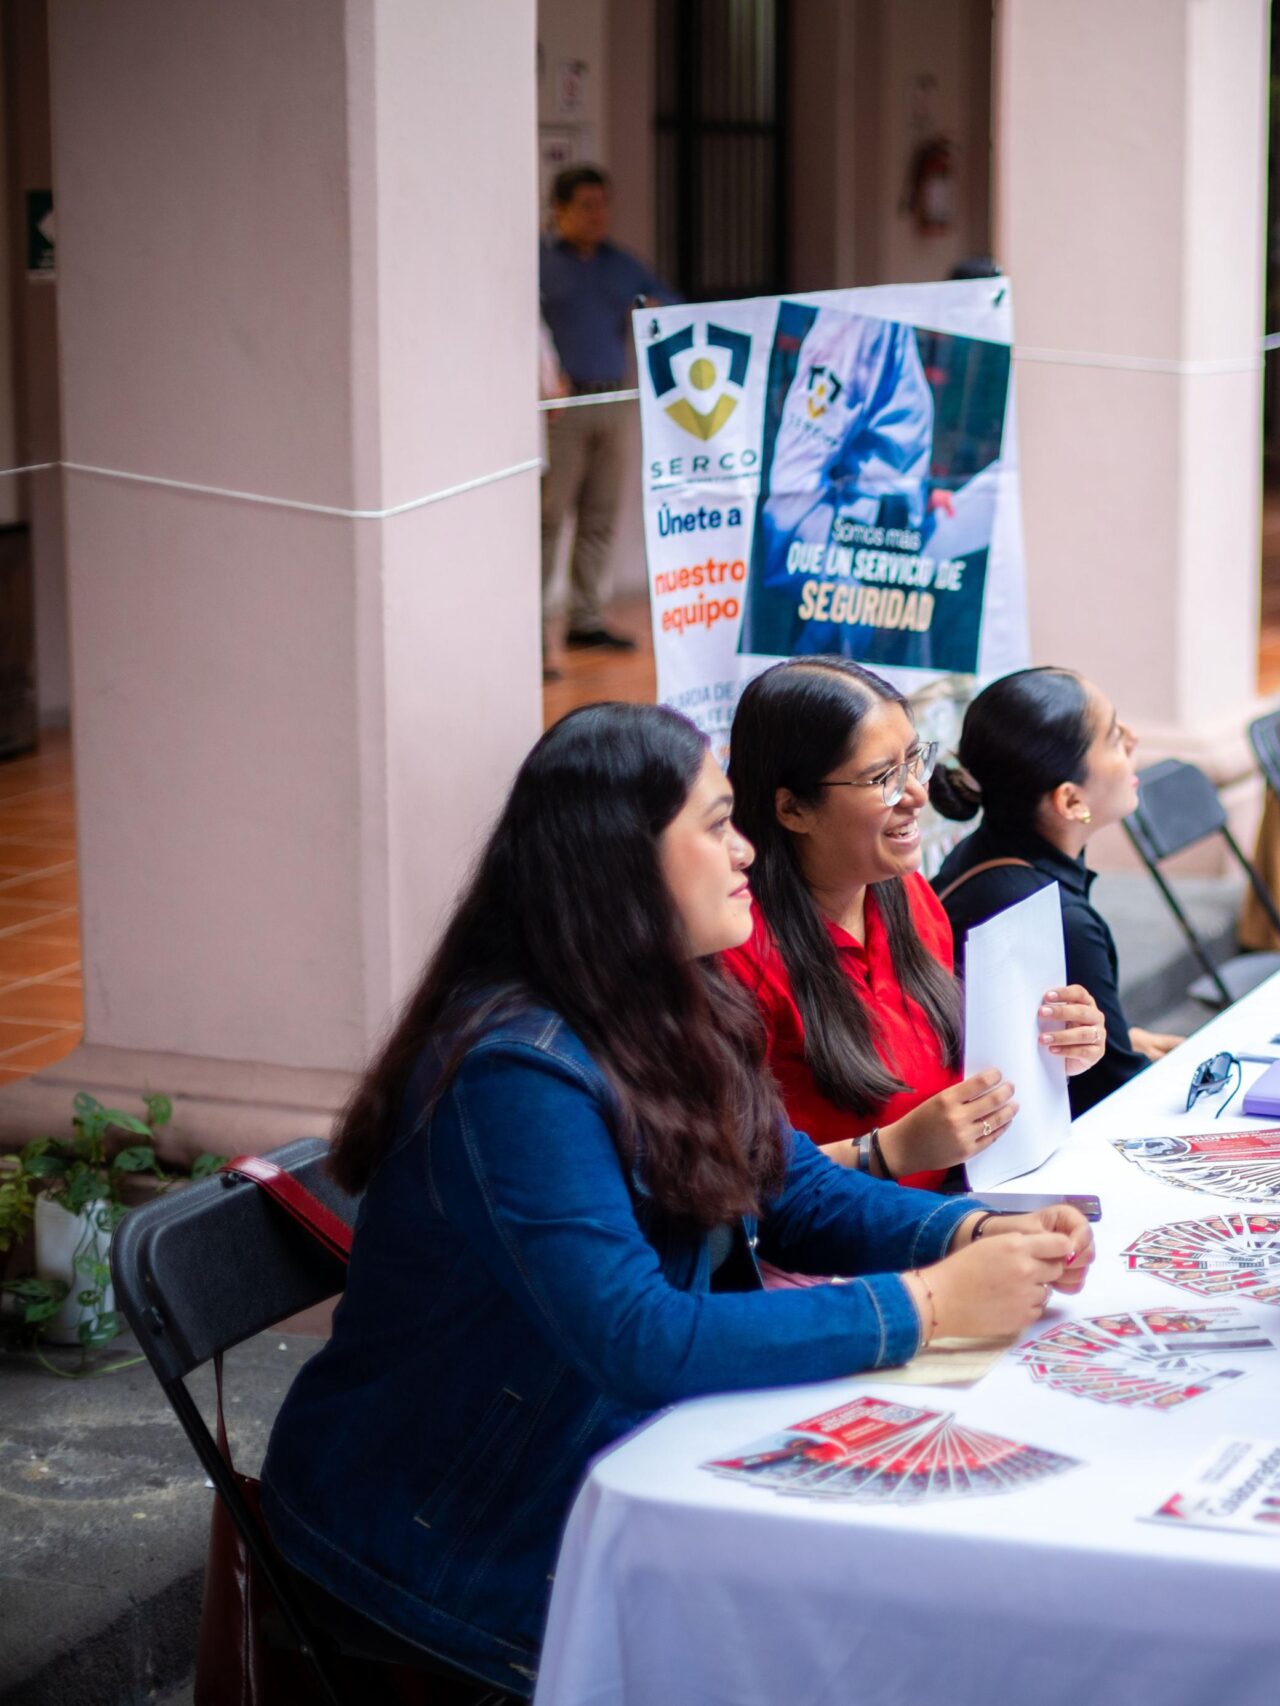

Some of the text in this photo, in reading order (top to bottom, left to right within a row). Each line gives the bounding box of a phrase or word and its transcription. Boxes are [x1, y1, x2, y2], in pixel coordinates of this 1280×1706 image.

[650, 449, 758, 479] SERCO
[658, 503, 742, 538] Únete a
[832, 517, 884, 547] Somos
[655, 556, 746, 596] nuestro
[787, 540, 967, 592] QUE UN SERVICIO DE
[661, 592, 740, 637] equipo
[798, 579, 936, 633] SEGURIDAD
